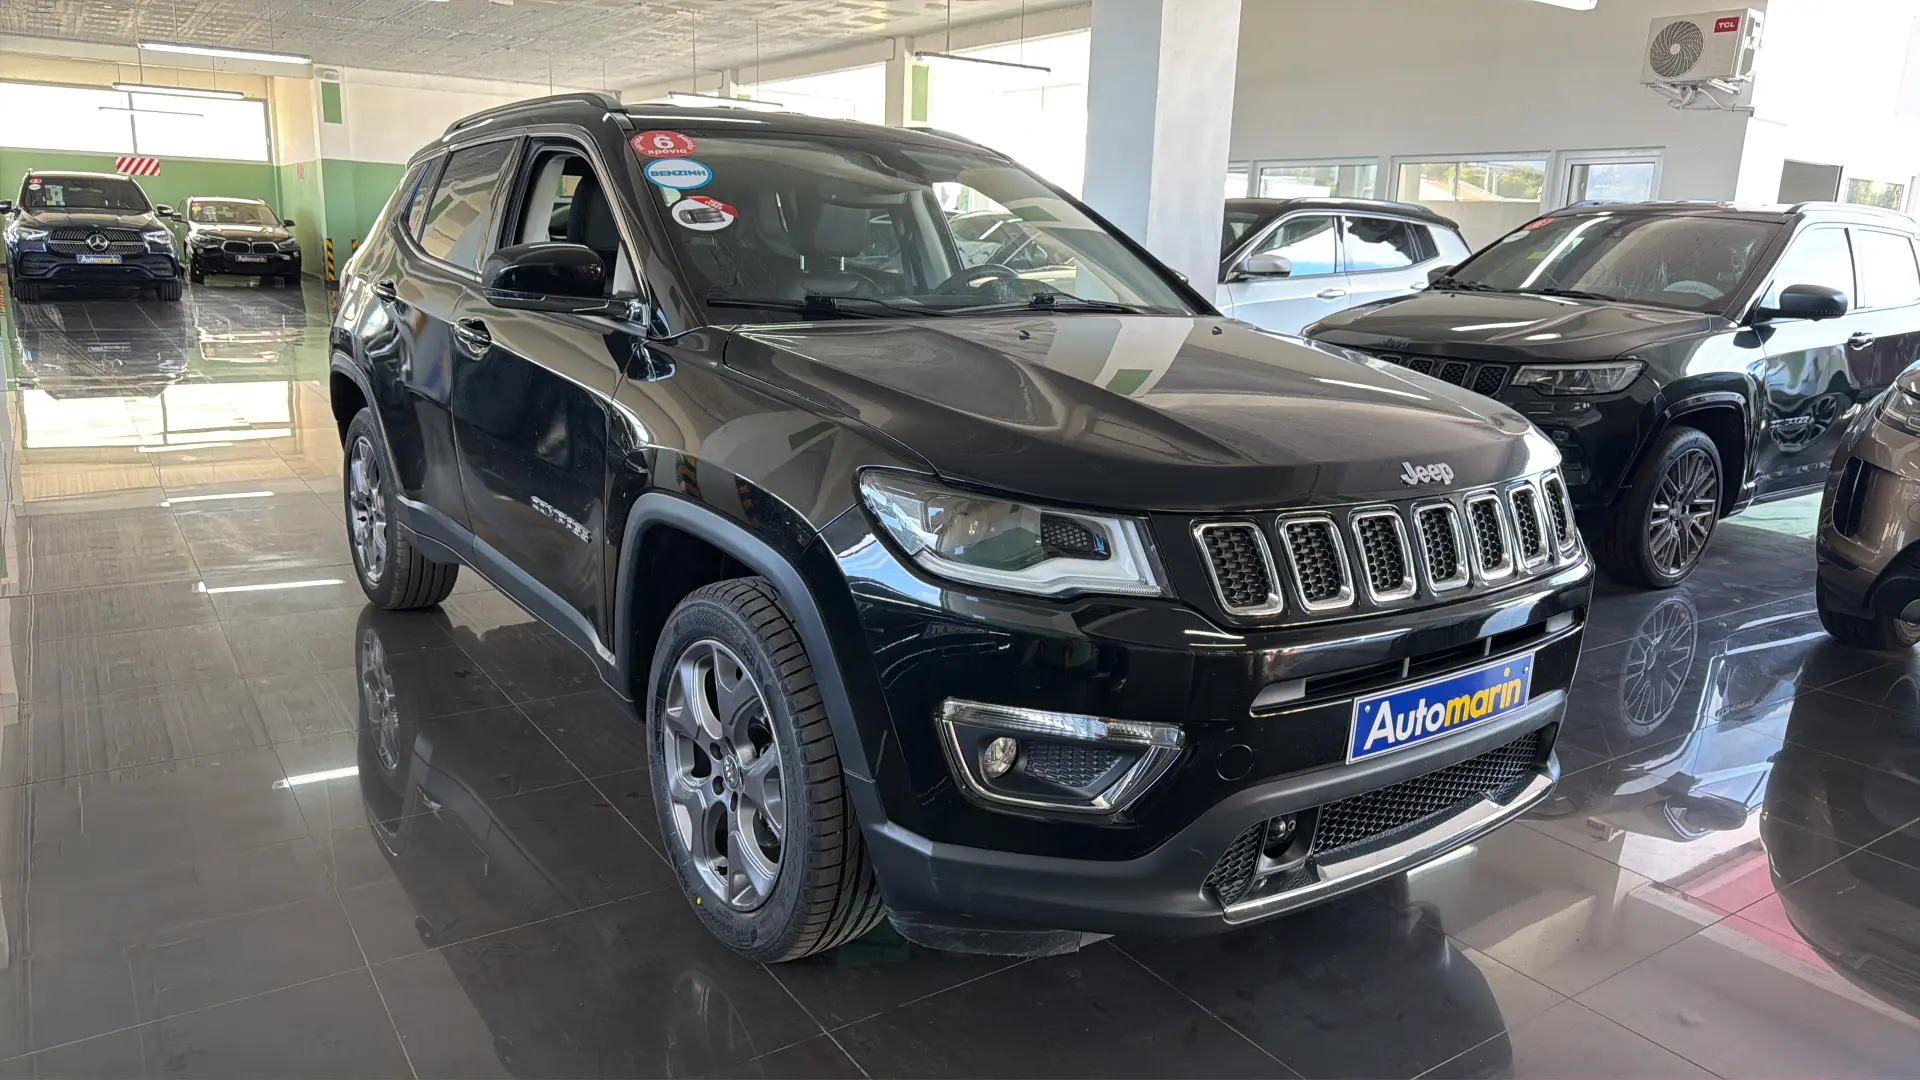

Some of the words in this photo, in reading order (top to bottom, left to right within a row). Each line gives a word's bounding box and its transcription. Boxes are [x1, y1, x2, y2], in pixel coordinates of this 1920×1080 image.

[1718, 21, 1735, 29] TCL
[653, 136, 675, 148] 6
[648, 148, 688, 156] χρόνια
[80, 255, 119, 264] Automarin
[1400, 461, 1454, 485] Jeep
[1363, 667, 1522, 750] Automarin
